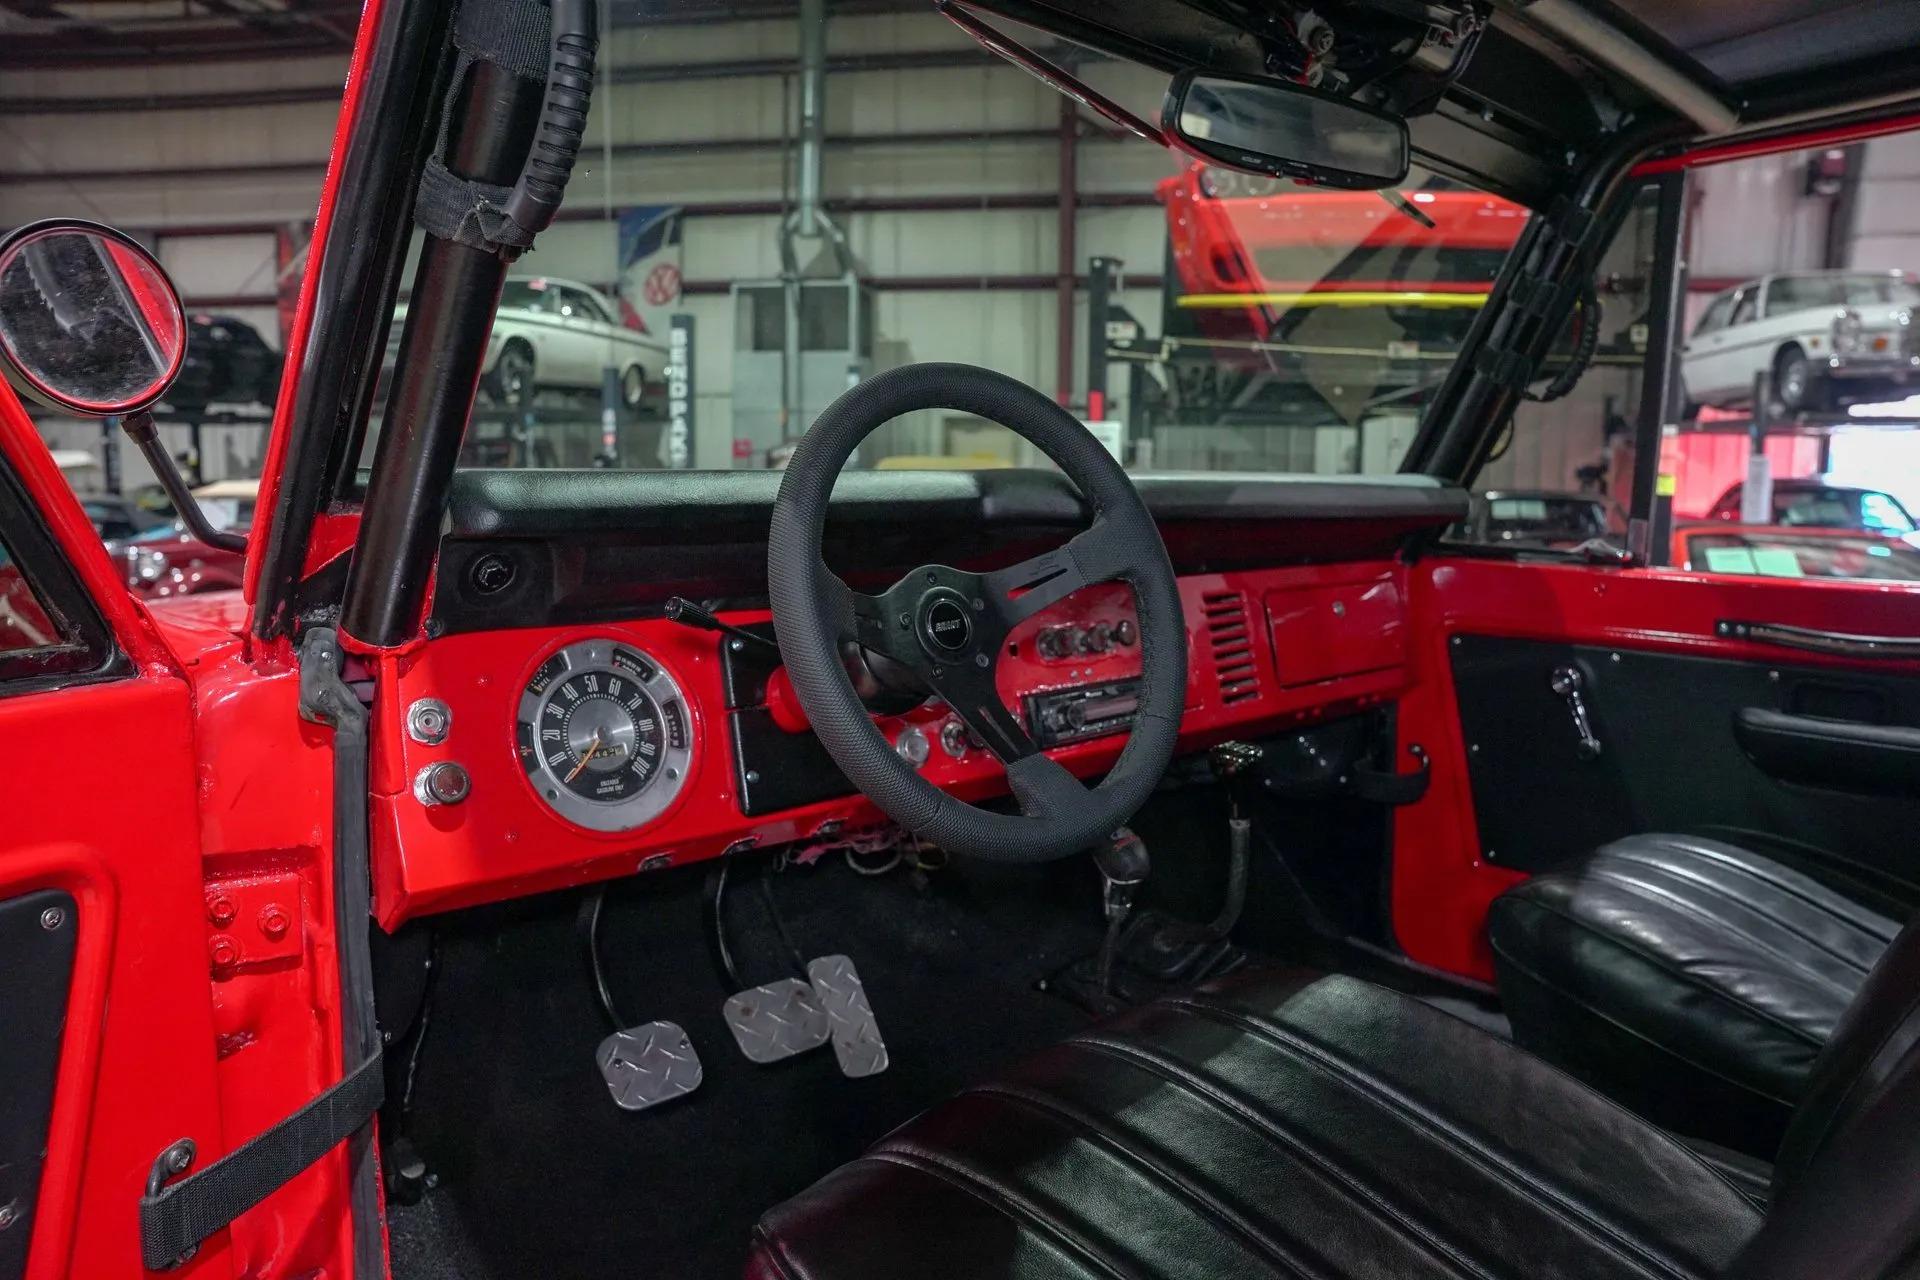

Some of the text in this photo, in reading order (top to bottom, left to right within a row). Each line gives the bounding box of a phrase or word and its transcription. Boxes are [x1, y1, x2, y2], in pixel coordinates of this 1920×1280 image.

[562, 682, 579, 702] 40
[584, 674, 599, 693] 50
[608, 677, 622, 697] 60
[546, 702, 566, 719] 30
[626, 693, 643, 711] 70
[638, 718, 654, 732] 80
[542, 729, 561, 741] 20
[640, 741, 656, 756] 90
[548, 751, 568, 767] 10
[631, 756, 651, 781] 100
